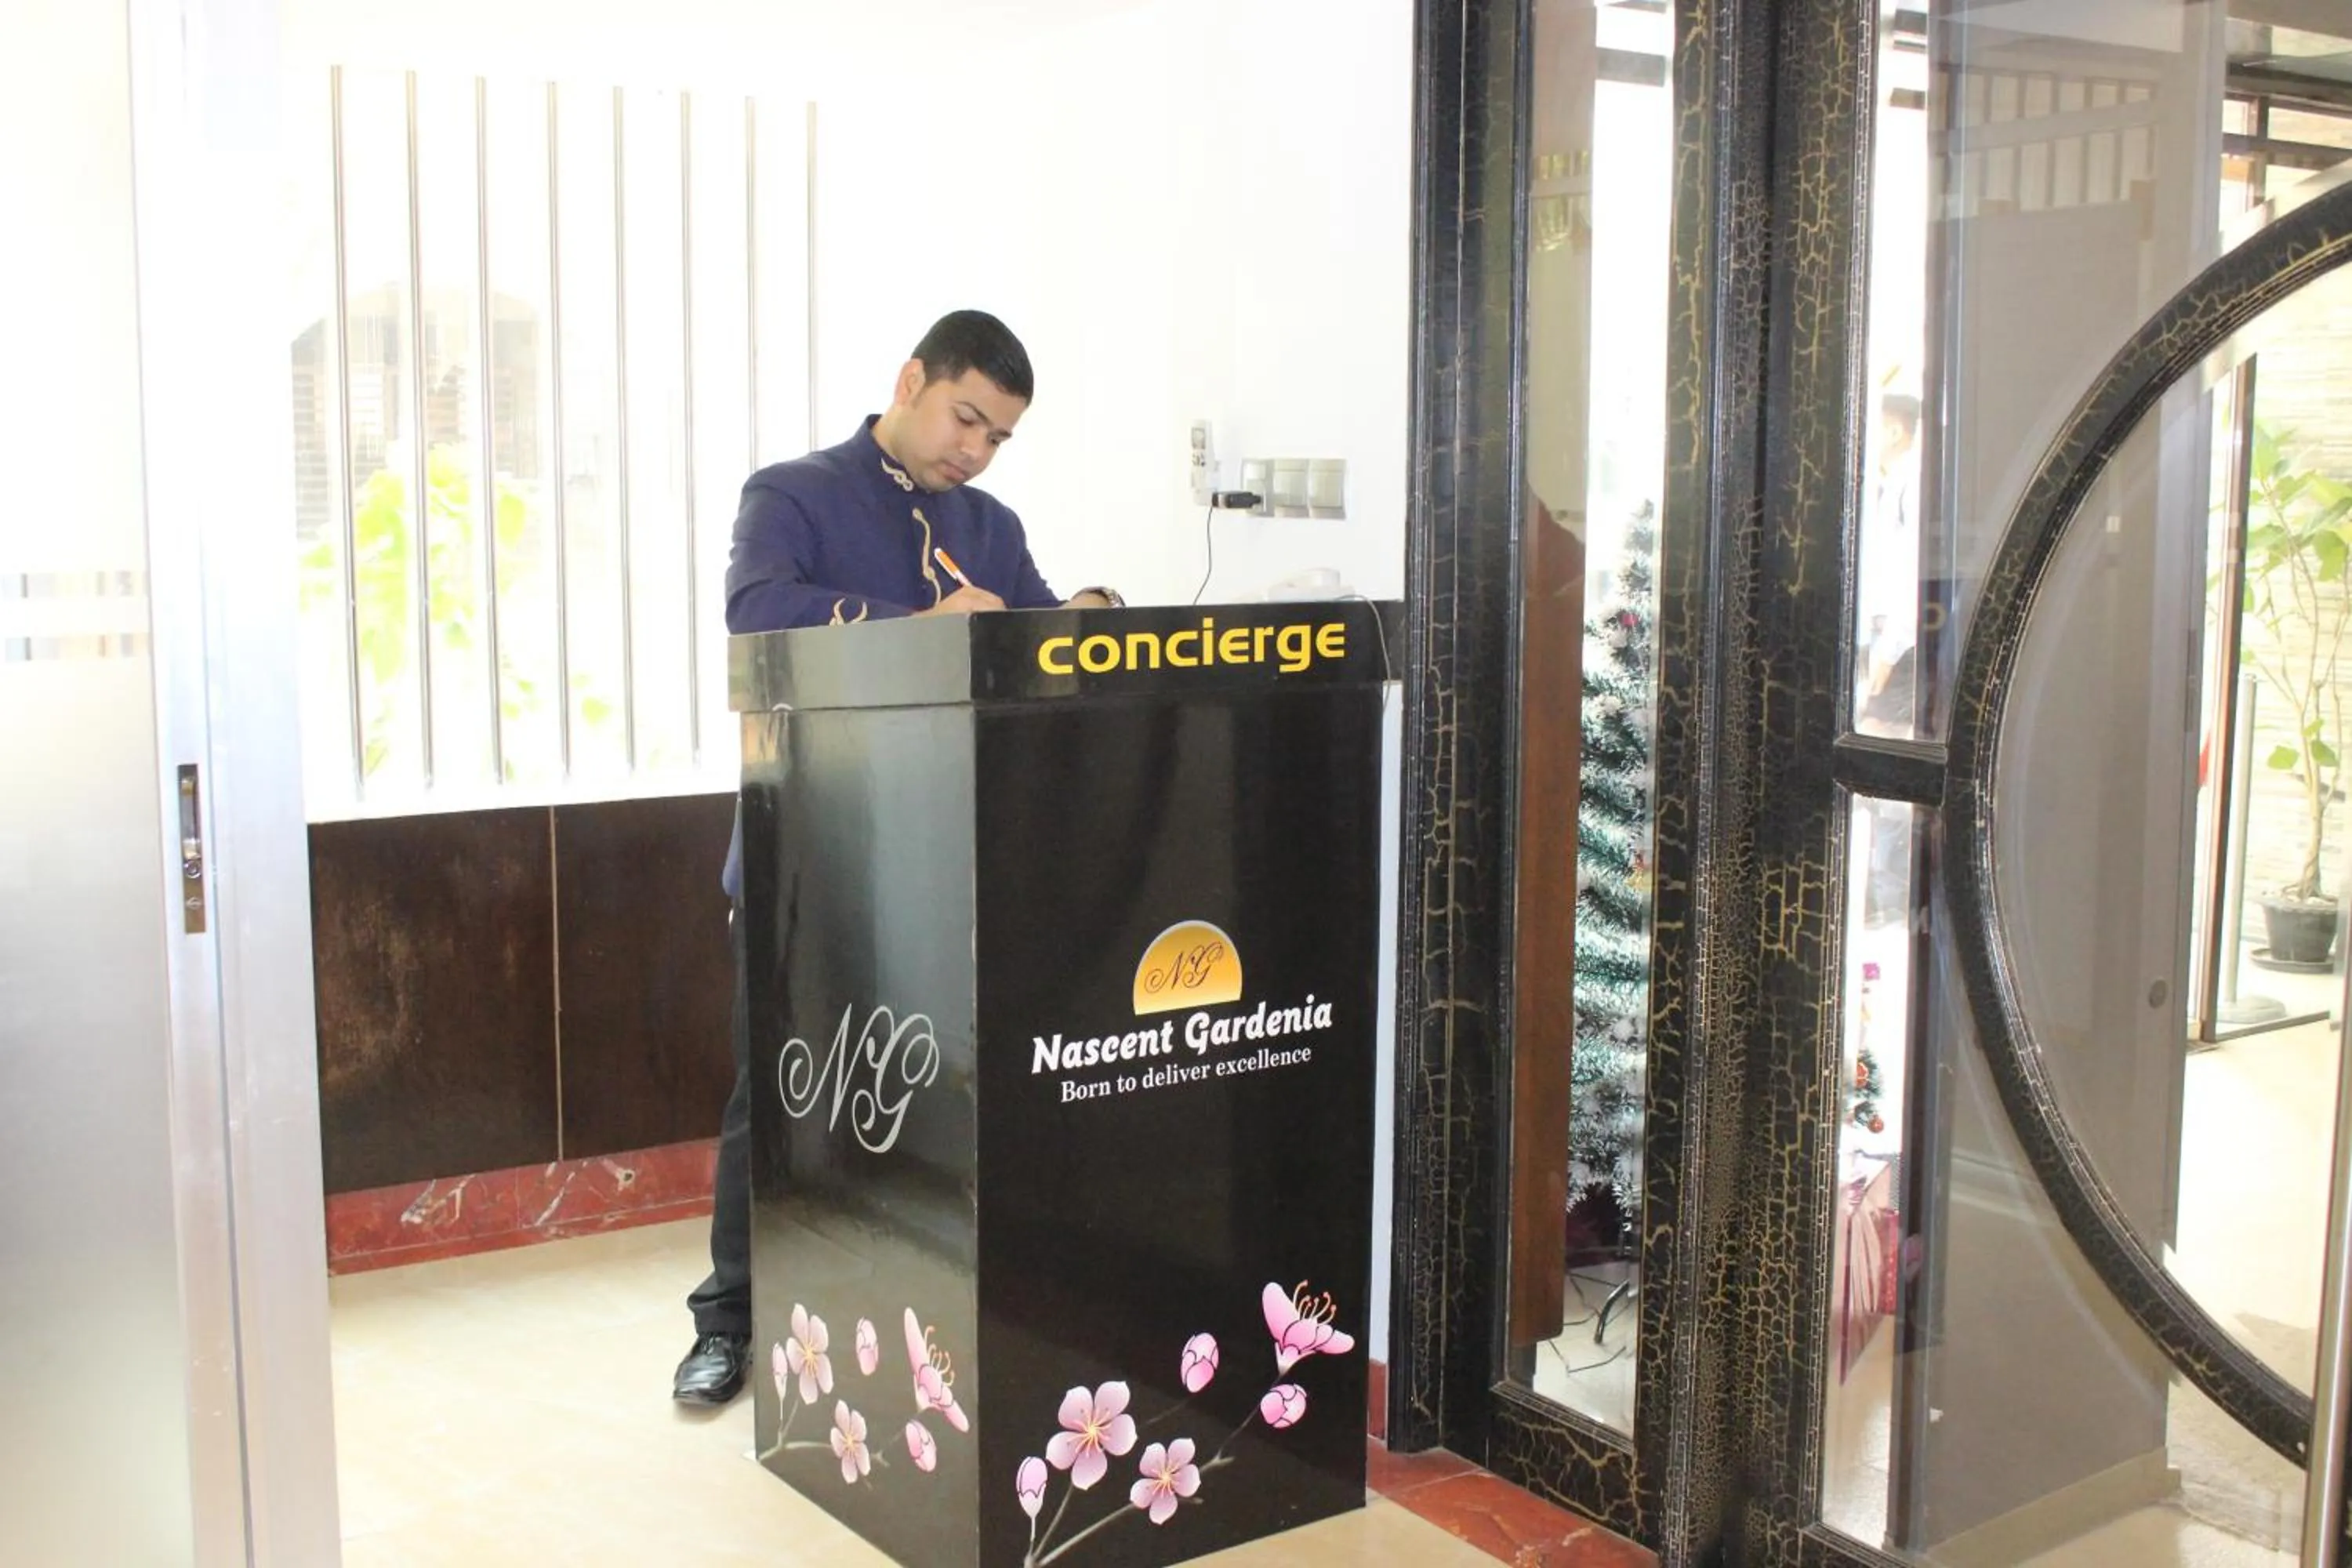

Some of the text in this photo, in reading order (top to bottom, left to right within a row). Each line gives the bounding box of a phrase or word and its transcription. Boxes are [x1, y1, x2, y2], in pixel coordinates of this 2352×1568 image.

[1038, 616, 1345, 675] concierge
[1031, 993, 1332, 1074] Nascent Gardenia
[1061, 1047, 1312, 1102] Born to deliver excellence
